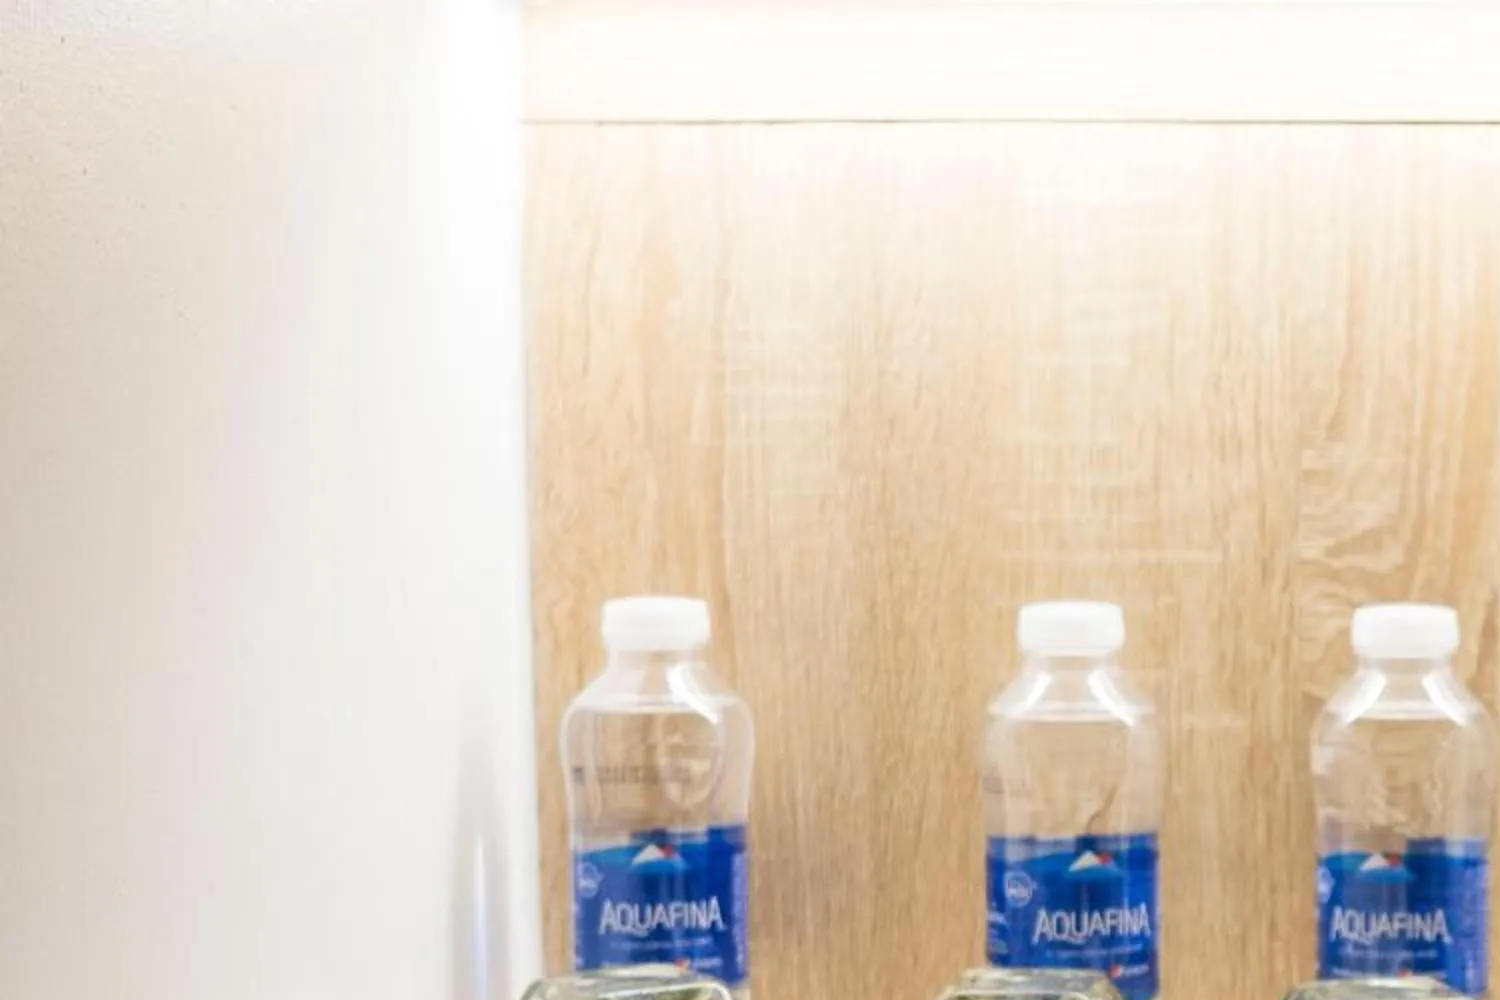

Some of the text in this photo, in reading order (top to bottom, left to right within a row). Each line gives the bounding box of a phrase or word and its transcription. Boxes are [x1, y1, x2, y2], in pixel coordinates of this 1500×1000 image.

[600, 896, 726, 937] AQUAFINA
[1032, 902, 1152, 945] AQUAFINA
[1330, 906, 1452, 945] AQUAFINA
